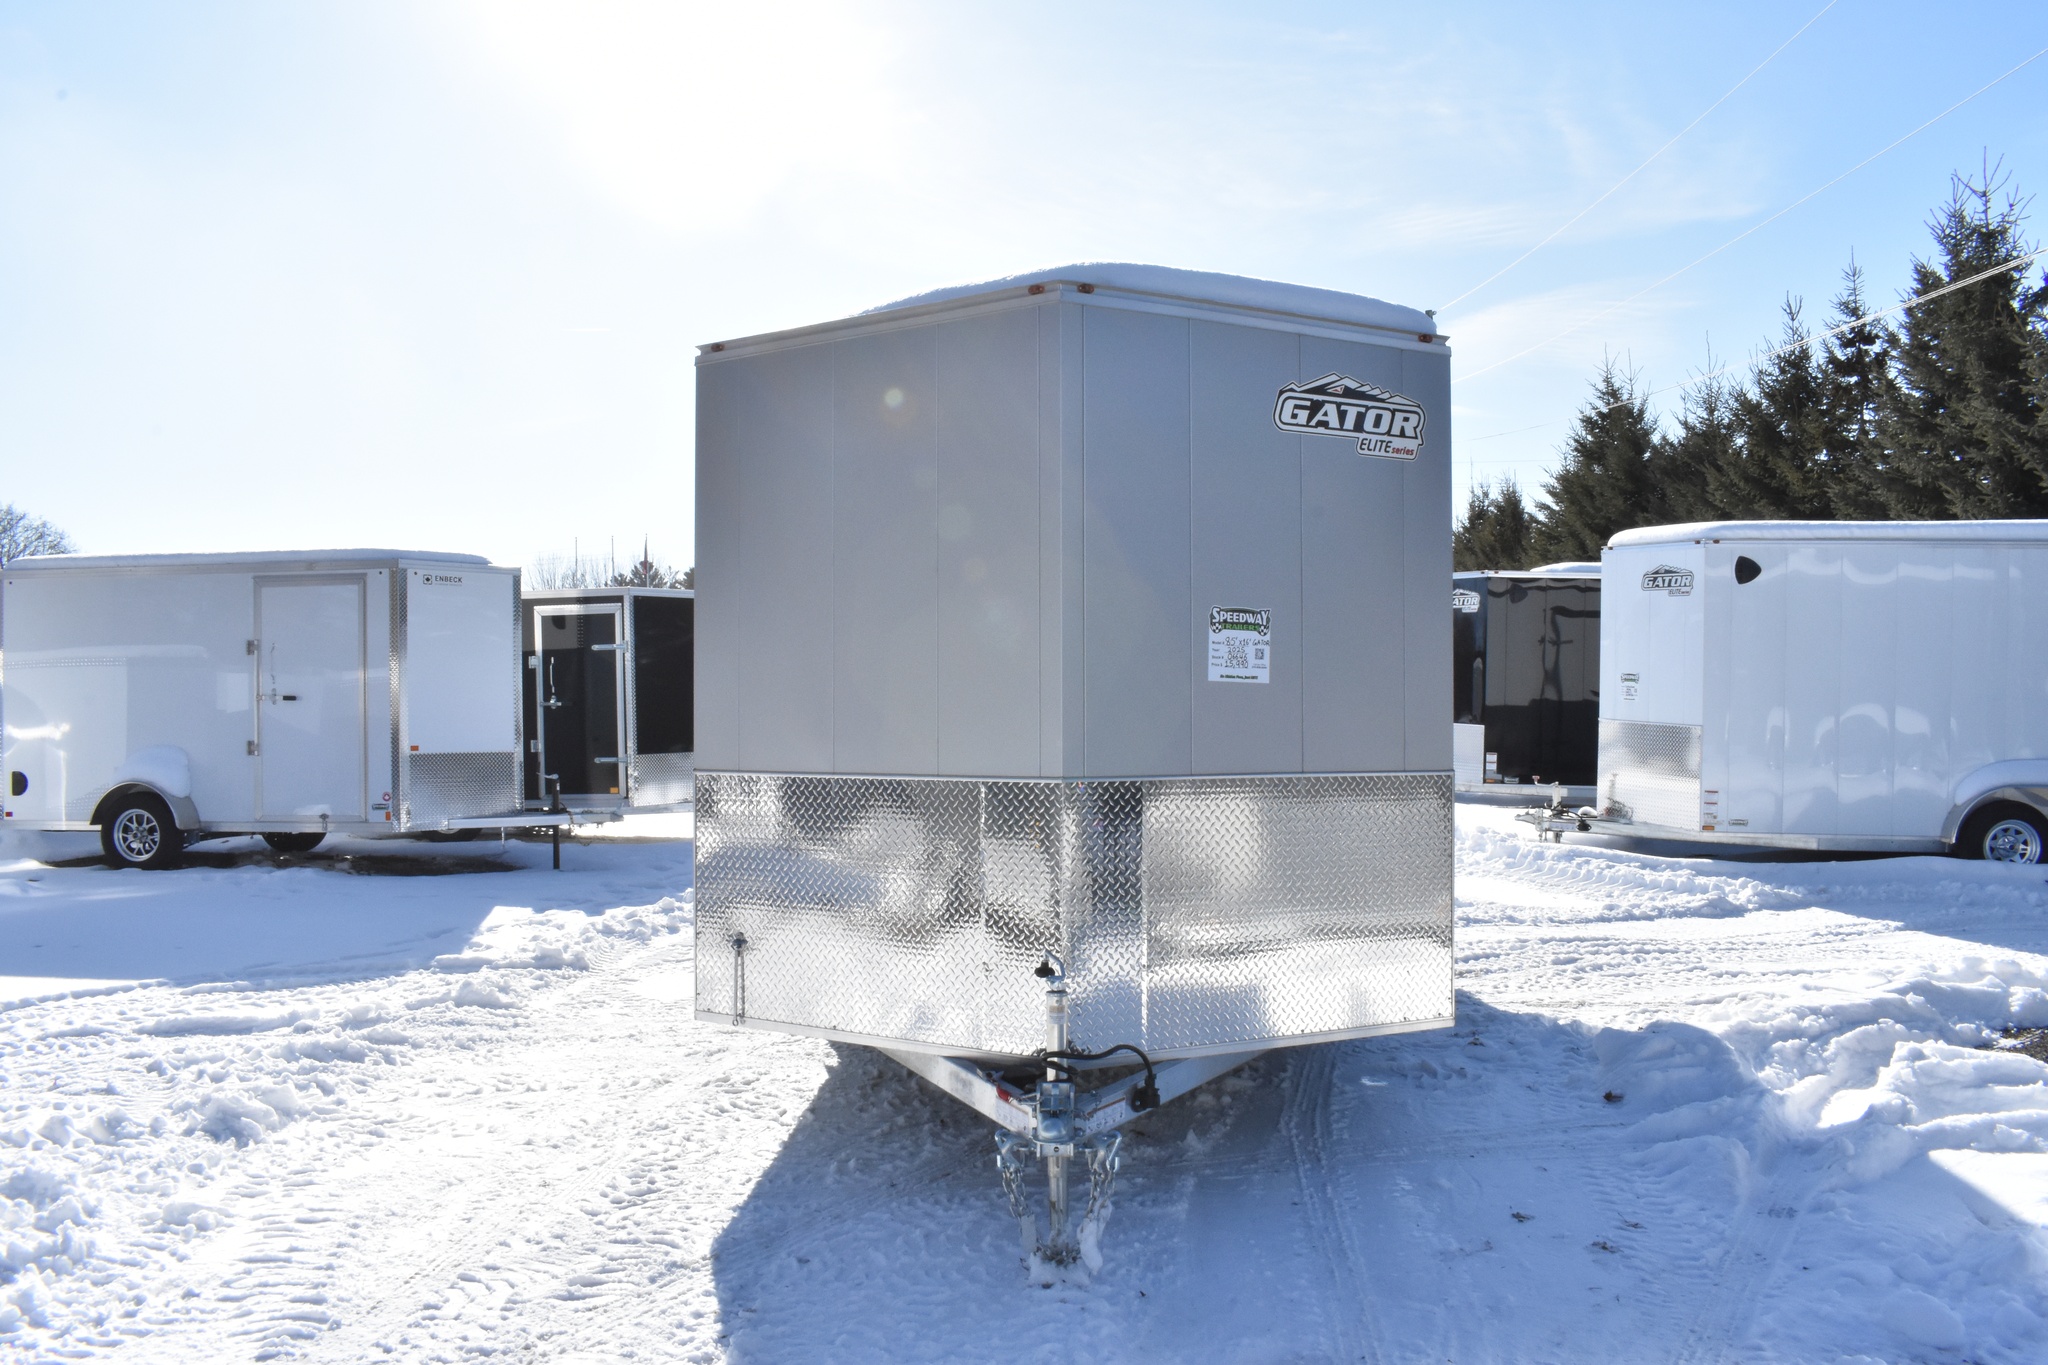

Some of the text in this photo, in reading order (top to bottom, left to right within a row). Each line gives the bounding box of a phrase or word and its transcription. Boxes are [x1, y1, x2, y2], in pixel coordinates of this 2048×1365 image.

[1280, 398, 1421, 438] GATOR
[1359, 438, 1415, 456] ELITE series
[1643, 575, 1692, 588] GATOR
[1453, 597, 1478, 606] ATOR
[1212, 606, 1270, 626] SPEEDWAY
[1221, 623, 1260, 631] TRAILERS
[1227, 646, 1246, 654] 2025
